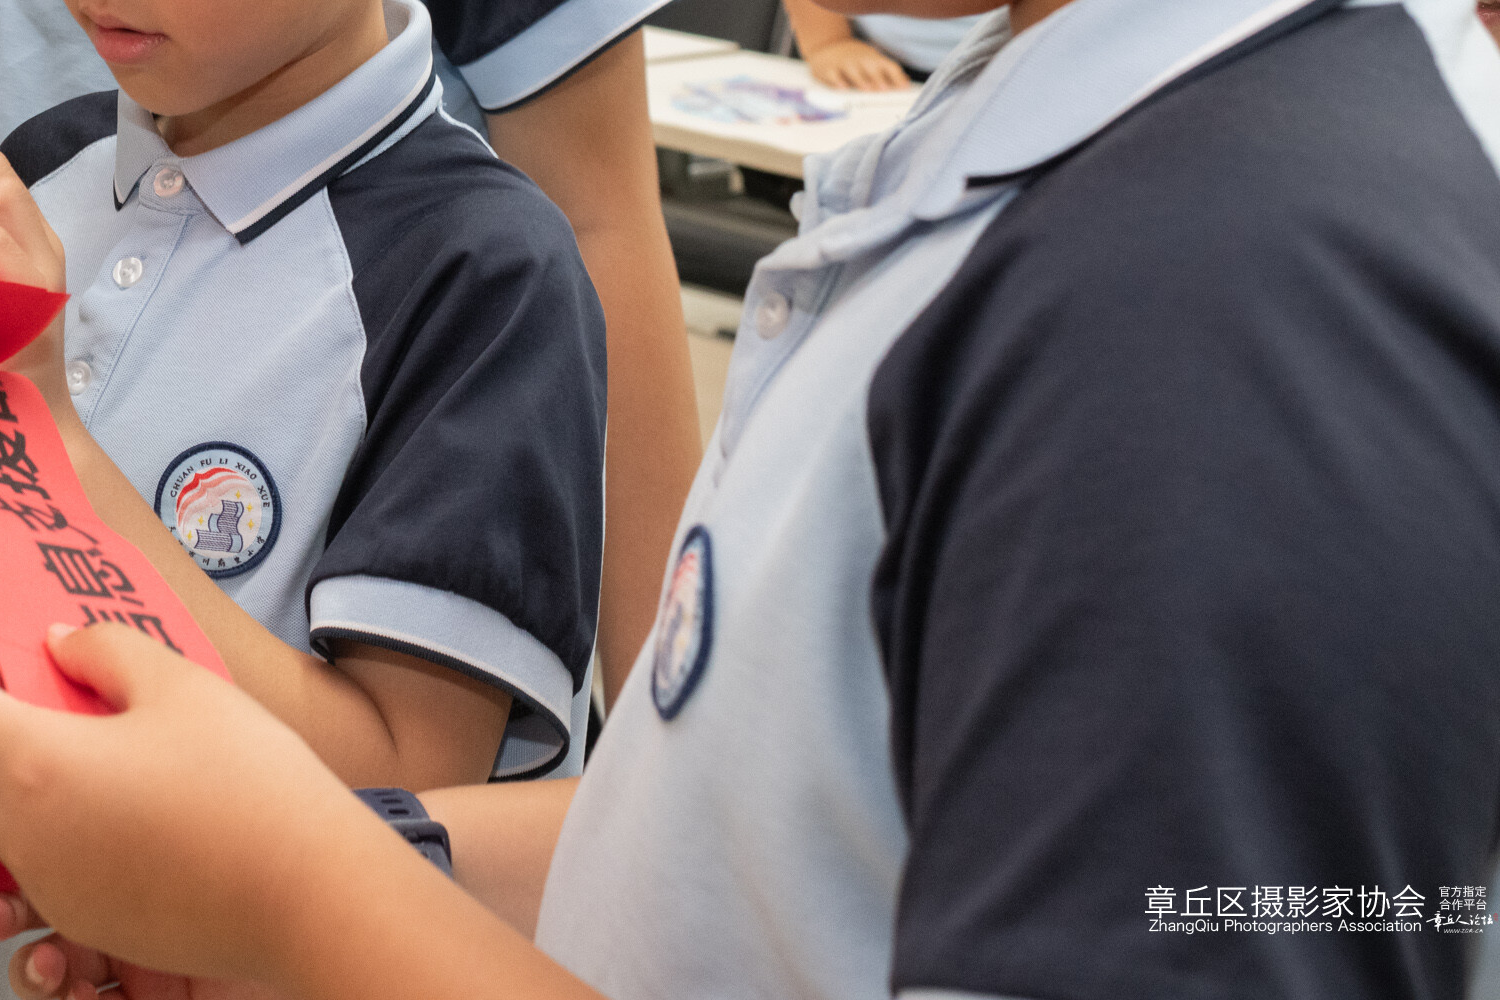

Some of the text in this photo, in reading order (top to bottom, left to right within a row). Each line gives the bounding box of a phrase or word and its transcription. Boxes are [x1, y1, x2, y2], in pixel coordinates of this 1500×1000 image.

[170, 466, 194, 498] CHUAN
[200, 458, 212, 467] FU
[235, 462, 257, 481] XIAO
[257, 485, 270, 508] XUE
